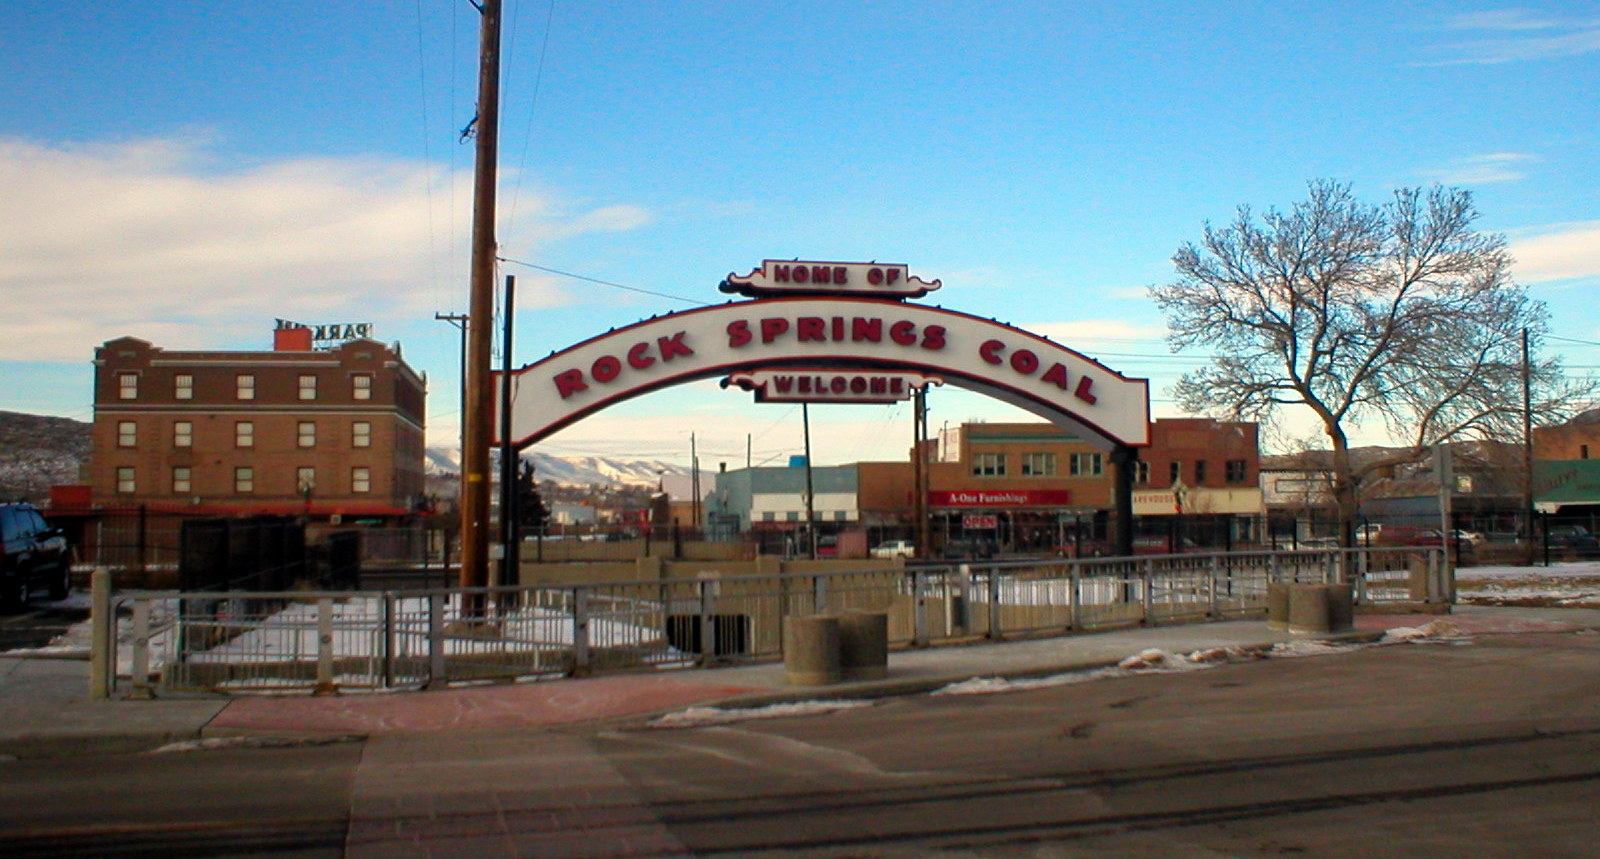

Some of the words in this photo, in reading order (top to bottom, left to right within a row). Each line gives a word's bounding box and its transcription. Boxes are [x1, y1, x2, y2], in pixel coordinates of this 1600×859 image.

[774, 265, 848, 284] HOME
[867, 267, 900, 285] OF
[553, 331, 695, 400] ROCK
[726, 316, 947, 350] SPRINGS
[979, 339, 1098, 405] COAL
[773, 375, 904, 394] WELCOME
[949, 493, 977, 503] A-One
[979, 493, 1027, 504] Furnishings
[963, 516, 996, 528] OPEN
